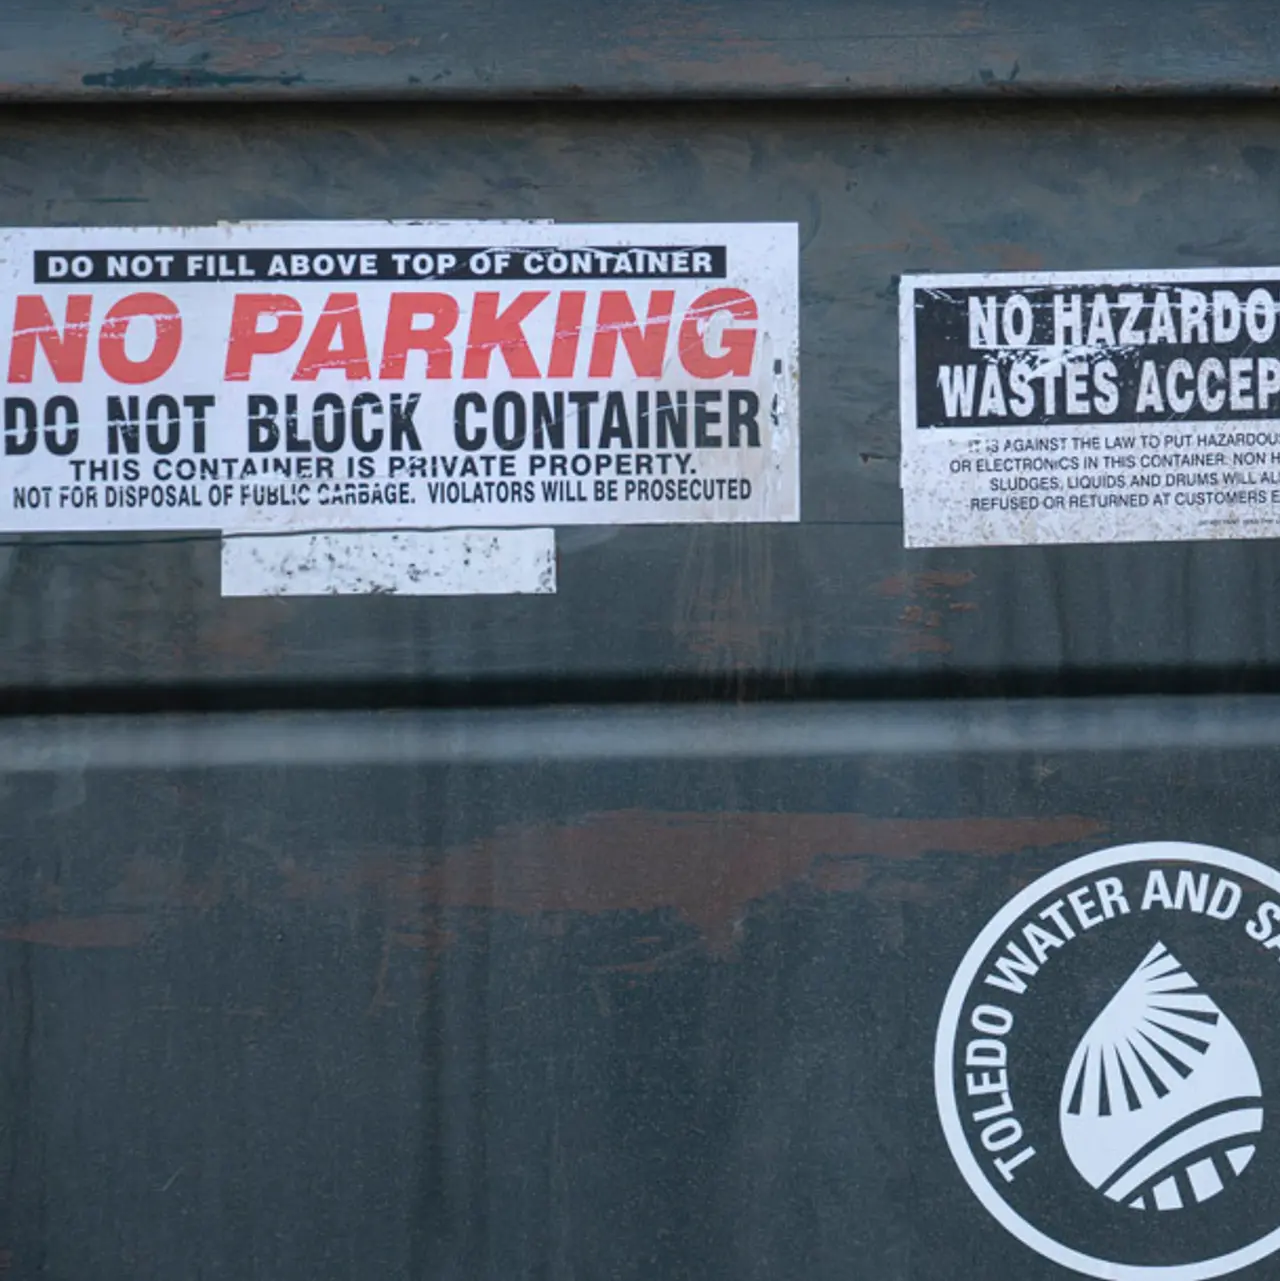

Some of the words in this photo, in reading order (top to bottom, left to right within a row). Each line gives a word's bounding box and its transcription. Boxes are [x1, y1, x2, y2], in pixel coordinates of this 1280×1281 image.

[48, 255, 94, 278] DO
[107, 255, 174, 277] NOT
[187, 254, 255, 277] FILL
[267, 253, 378, 277] ABOVE
[392, 252, 456, 275] TOP
[469, 253, 510, 275] OF
[523, 251, 713, 274] CONTAINER
[6, 291, 183, 385] NO
[223, 287, 759, 382] PARKING
[968, 294, 1034, 348] NO
[937, 358, 1120, 418] WASTES
[4, 395, 79, 455] DO
[106, 394, 215, 455] NOT
[247, 391, 422, 453] BLOCK
[454, 389, 761, 451] CONTAINER
[949, 459, 971, 473] OR
[976, 455, 1080, 472] ELECTRONICS
[1083, 455, 1099, 469] IN
[1103, 454, 1136, 469] THIS
[1232, 451, 1267, 465] NON
[1003, 437, 1068, 453] AGAINST
[1071, 436, 1100, 451] THE
[1104, 435, 1136, 450] LAW
[1139, 434, 1160, 449] TO
[1163, 434, 1193, 448] PUT
[69, 459, 139, 482] THIS
[153, 457, 334, 481] CONTAINER
[347, 456, 375, 479] IS
[388, 454, 516, 478] PRIVATE
[528, 452, 697, 476] PROPERTY.
[989, 476, 1064, 492] SLUDGES,
[1067, 475, 1126, 490] LIQUIDS
[1130, 474, 1161, 488] AND
[1165, 472, 1219, 487] DRUMS
[1222, 471, 1257, 485] WILL
[13, 485, 52, 509] NOT
[59, 485, 97, 508] FOR
[105, 484, 202, 508] DISPOSAL
[208, 483, 234, 507] OF
[427, 479, 535, 504] VIOLATORS
[542, 479, 587, 502] WILL
[593, 478, 619, 502] BE
[624, 477, 752, 501] PROSECUTED
[970, 496, 1039, 511] REFUSED
[1042, 495, 1065, 510] OR
[1069, 493, 1149, 509] RETURNED
[1153, 492, 1170, 506] AT
[1173, 490, 1267, 506] CUSTOMERS
[1141, 869, 1242, 920] AND
[984, 875, 1131, 995] WATER
[965, 1004, 1037, 1183] TOLEDO
